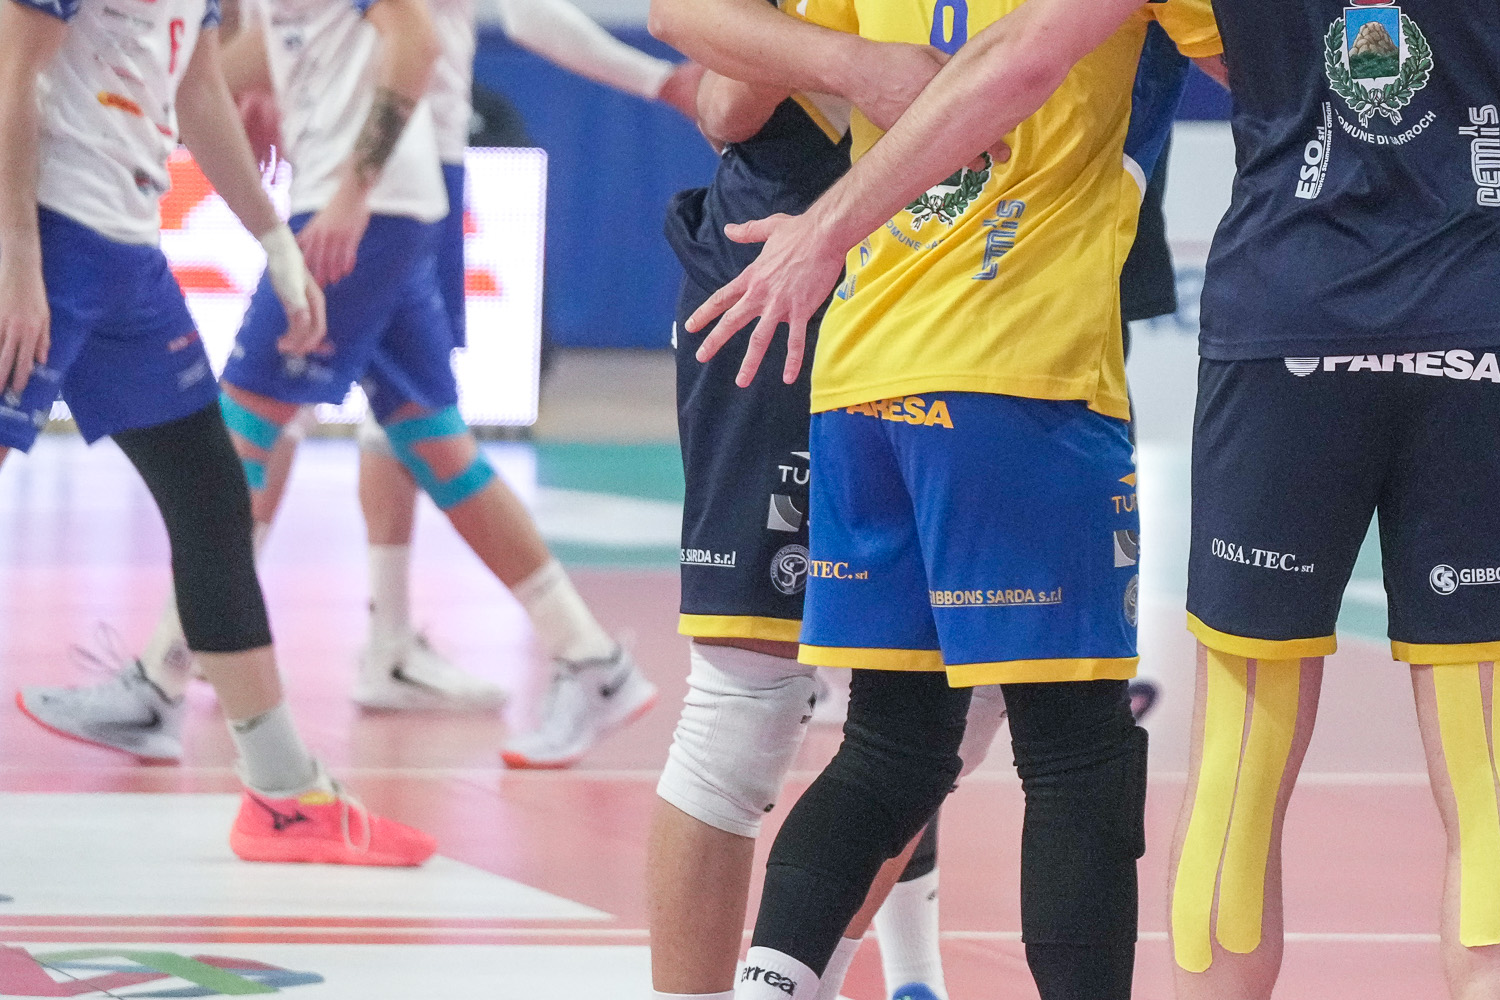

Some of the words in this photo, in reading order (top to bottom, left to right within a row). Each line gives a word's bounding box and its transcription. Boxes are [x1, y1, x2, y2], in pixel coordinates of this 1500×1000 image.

[1334, 108, 1375, 144] OMUNE
[1377, 134, 1389, 145] DI
[1295, 140, 1323, 199] ESO
[1301, 563, 1315, 573] srl
[930, 590, 984, 605] IBBONS
[986, 589, 1036, 604] SARDA
